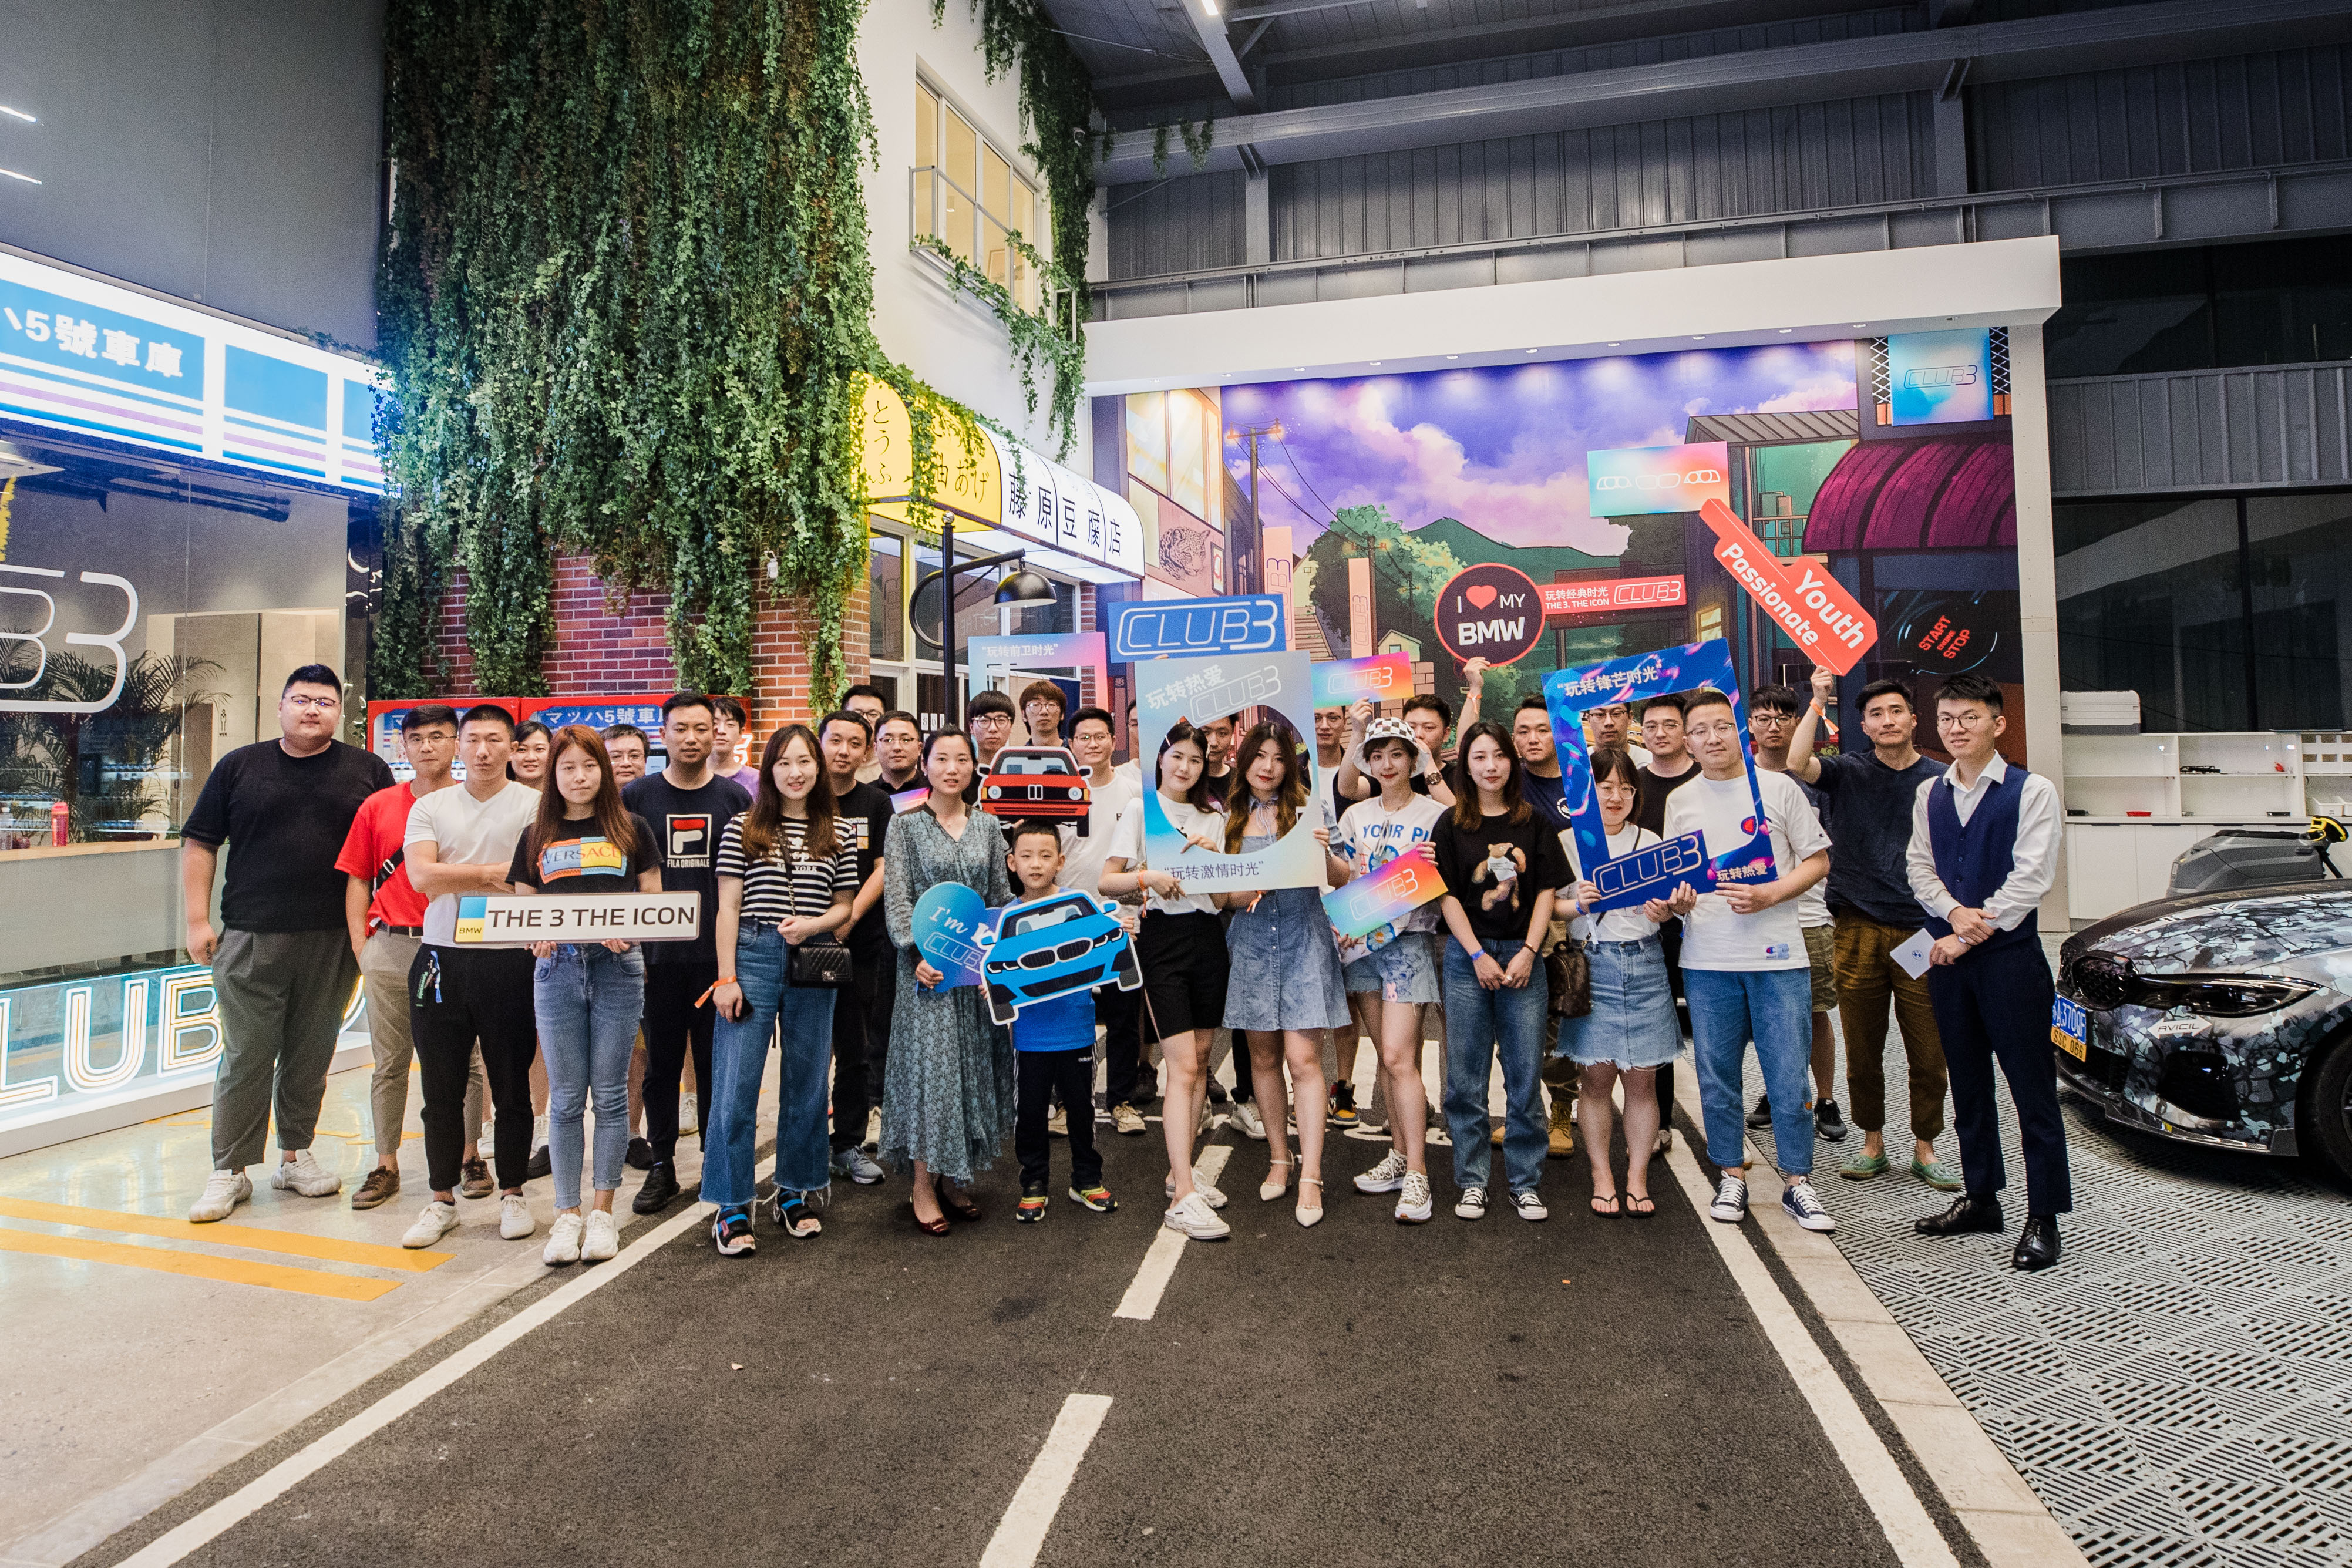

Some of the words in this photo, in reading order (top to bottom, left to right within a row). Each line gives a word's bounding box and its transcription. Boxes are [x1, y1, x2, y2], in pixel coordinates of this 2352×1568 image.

[1904, 365, 1978, 389] CLUB3
[870, 399, 892, 484] とうふ
[1457, 595, 1462, 613] I
[1500, 593, 1526, 609] MY
[1545, 586, 1609, 601] 玩转经典时光
[1545, 601, 1562, 610] THE
[1571, 600, 1588, 608] THE
[1589, 598, 1610, 607] ICON
[1614, 580, 1681, 605] CLUB3
[1721, 543, 1819, 646] Passionate
[1795, 568, 1865, 649] Youth
[1117, 600, 1278, 655] CLUB3
[1458, 616, 1525, 646] BMW
[1918, 615, 1951, 651] START
[1943, 629, 1970, 659] STOP
[1145, 664, 1226, 710] 玩转热爱
[1190, 665, 1281, 724] CLUB3
[1328, 667, 1392, 694] CLUB3
[667, 859, 680, 868] FILA
[681, 858, 710, 868] ORIGINALE
[1593, 835, 1702, 900] CLUB3
[1716, 862, 1768, 882] 玩转热爱
[1350, 868, 1418, 921] CLUB3
[488, 909, 543, 927] THE
[550, 909, 564, 927] 3
[572, 908, 625, 926] THE
[634, 906, 695, 925] ICON
[929, 906, 968, 934] I'm
[924, 931, 984, 974] CLUB
